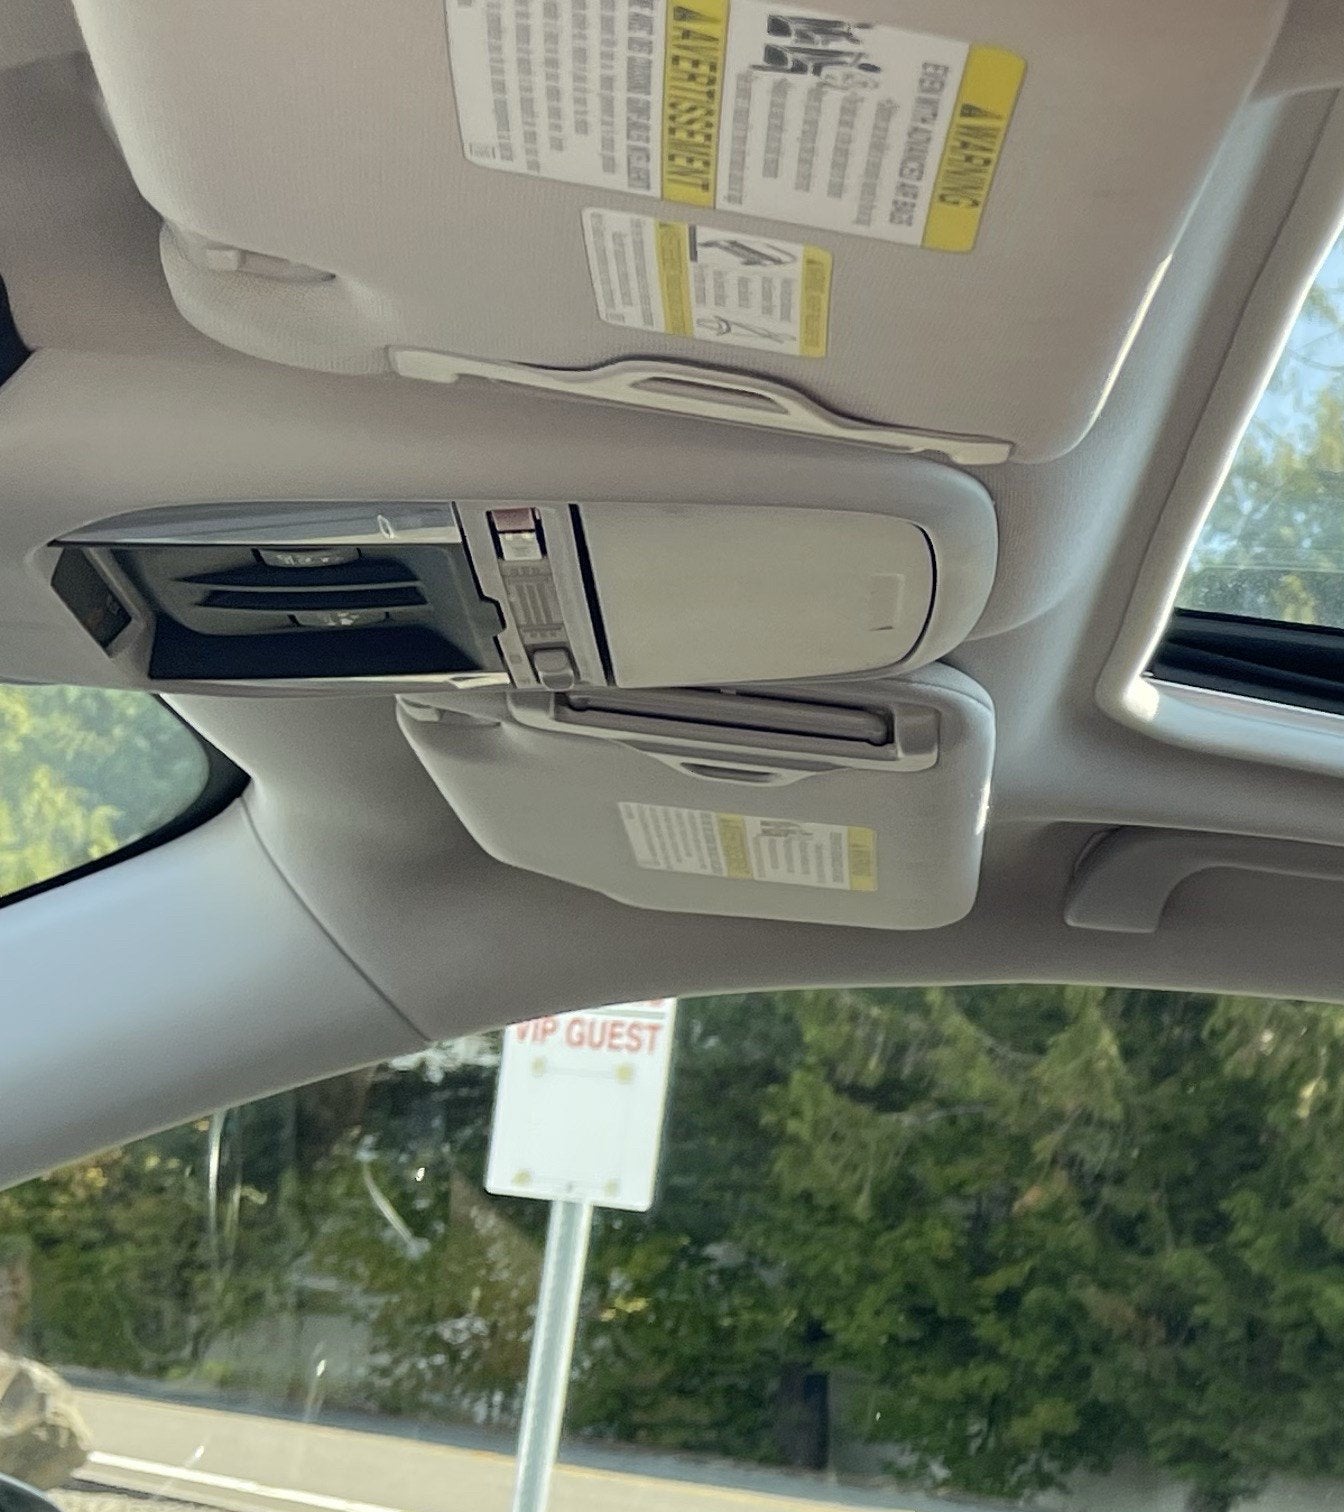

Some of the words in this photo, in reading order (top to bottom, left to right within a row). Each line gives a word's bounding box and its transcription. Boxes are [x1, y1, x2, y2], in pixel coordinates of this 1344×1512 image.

[665, 25, 720, 192] AVERTISSEMENT
[938, 123, 1003, 208] WARNING
[565, 1017, 663, 1055] GUEST
